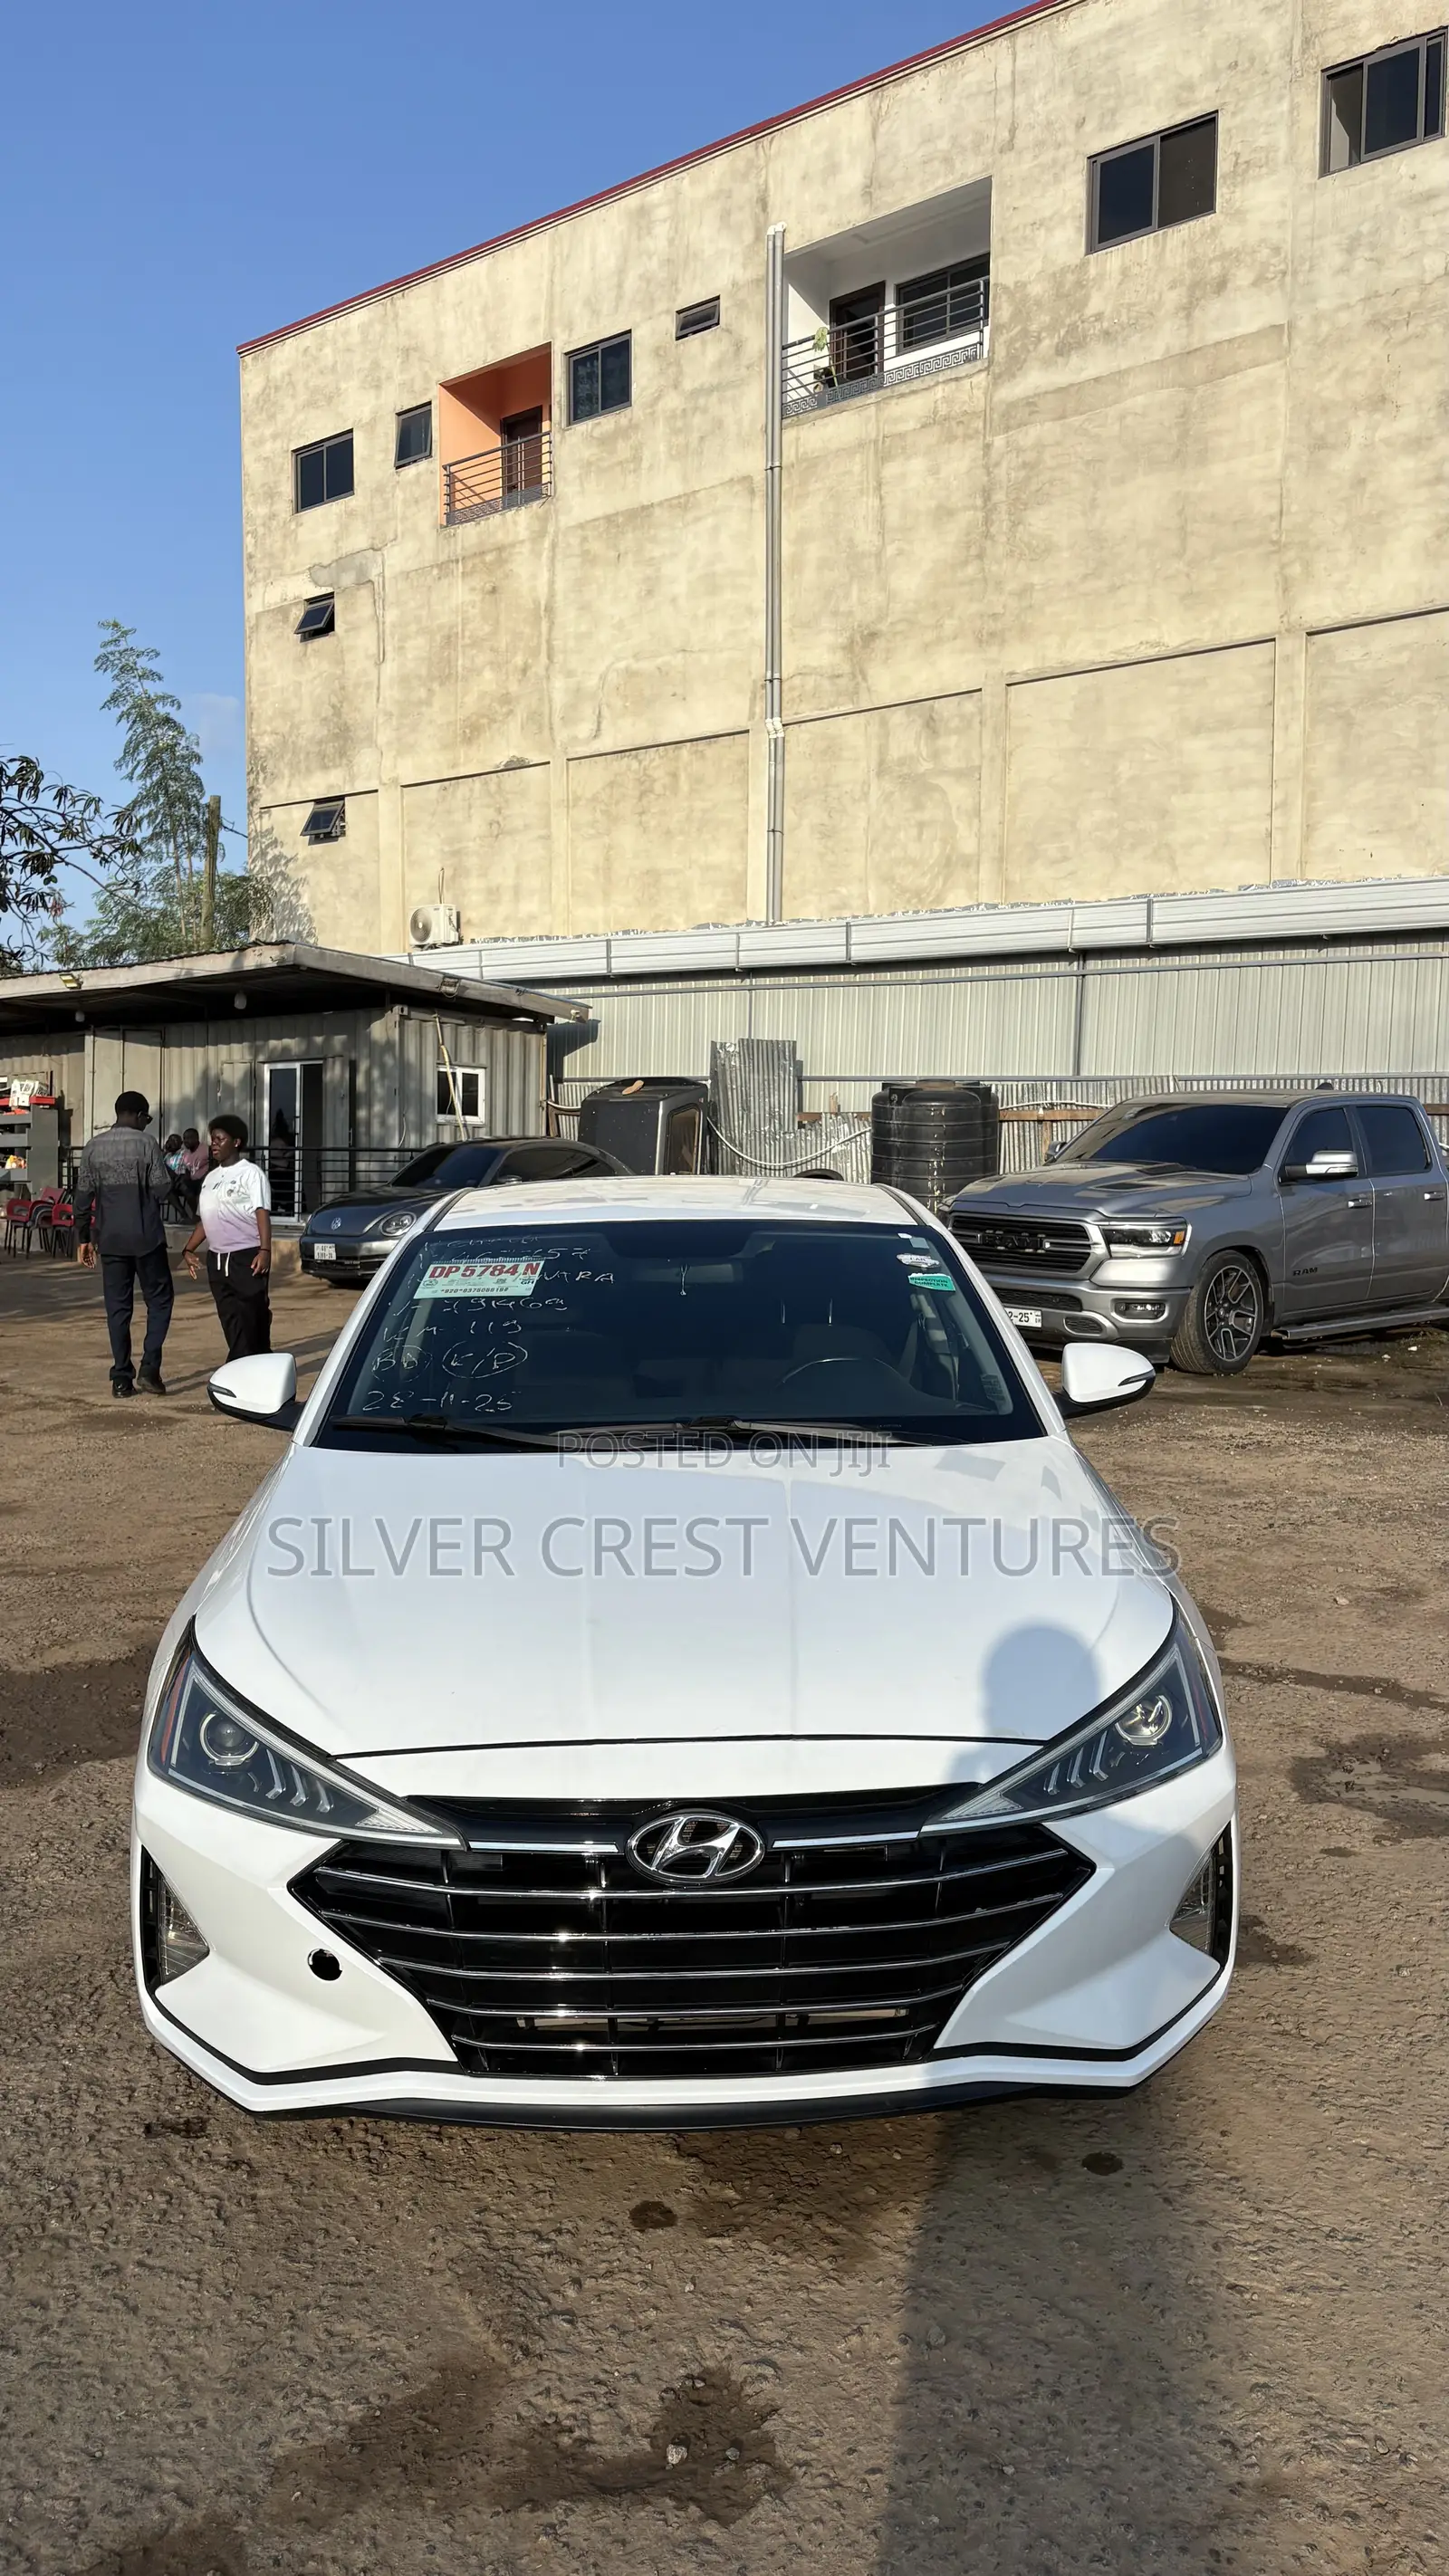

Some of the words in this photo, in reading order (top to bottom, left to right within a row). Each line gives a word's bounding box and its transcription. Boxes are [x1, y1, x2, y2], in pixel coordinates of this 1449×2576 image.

[428, 1266, 459, 1278] DP
[461, 1263, 520, 1278] 5784
[1292, 1267, 1318, 1277] RAM
